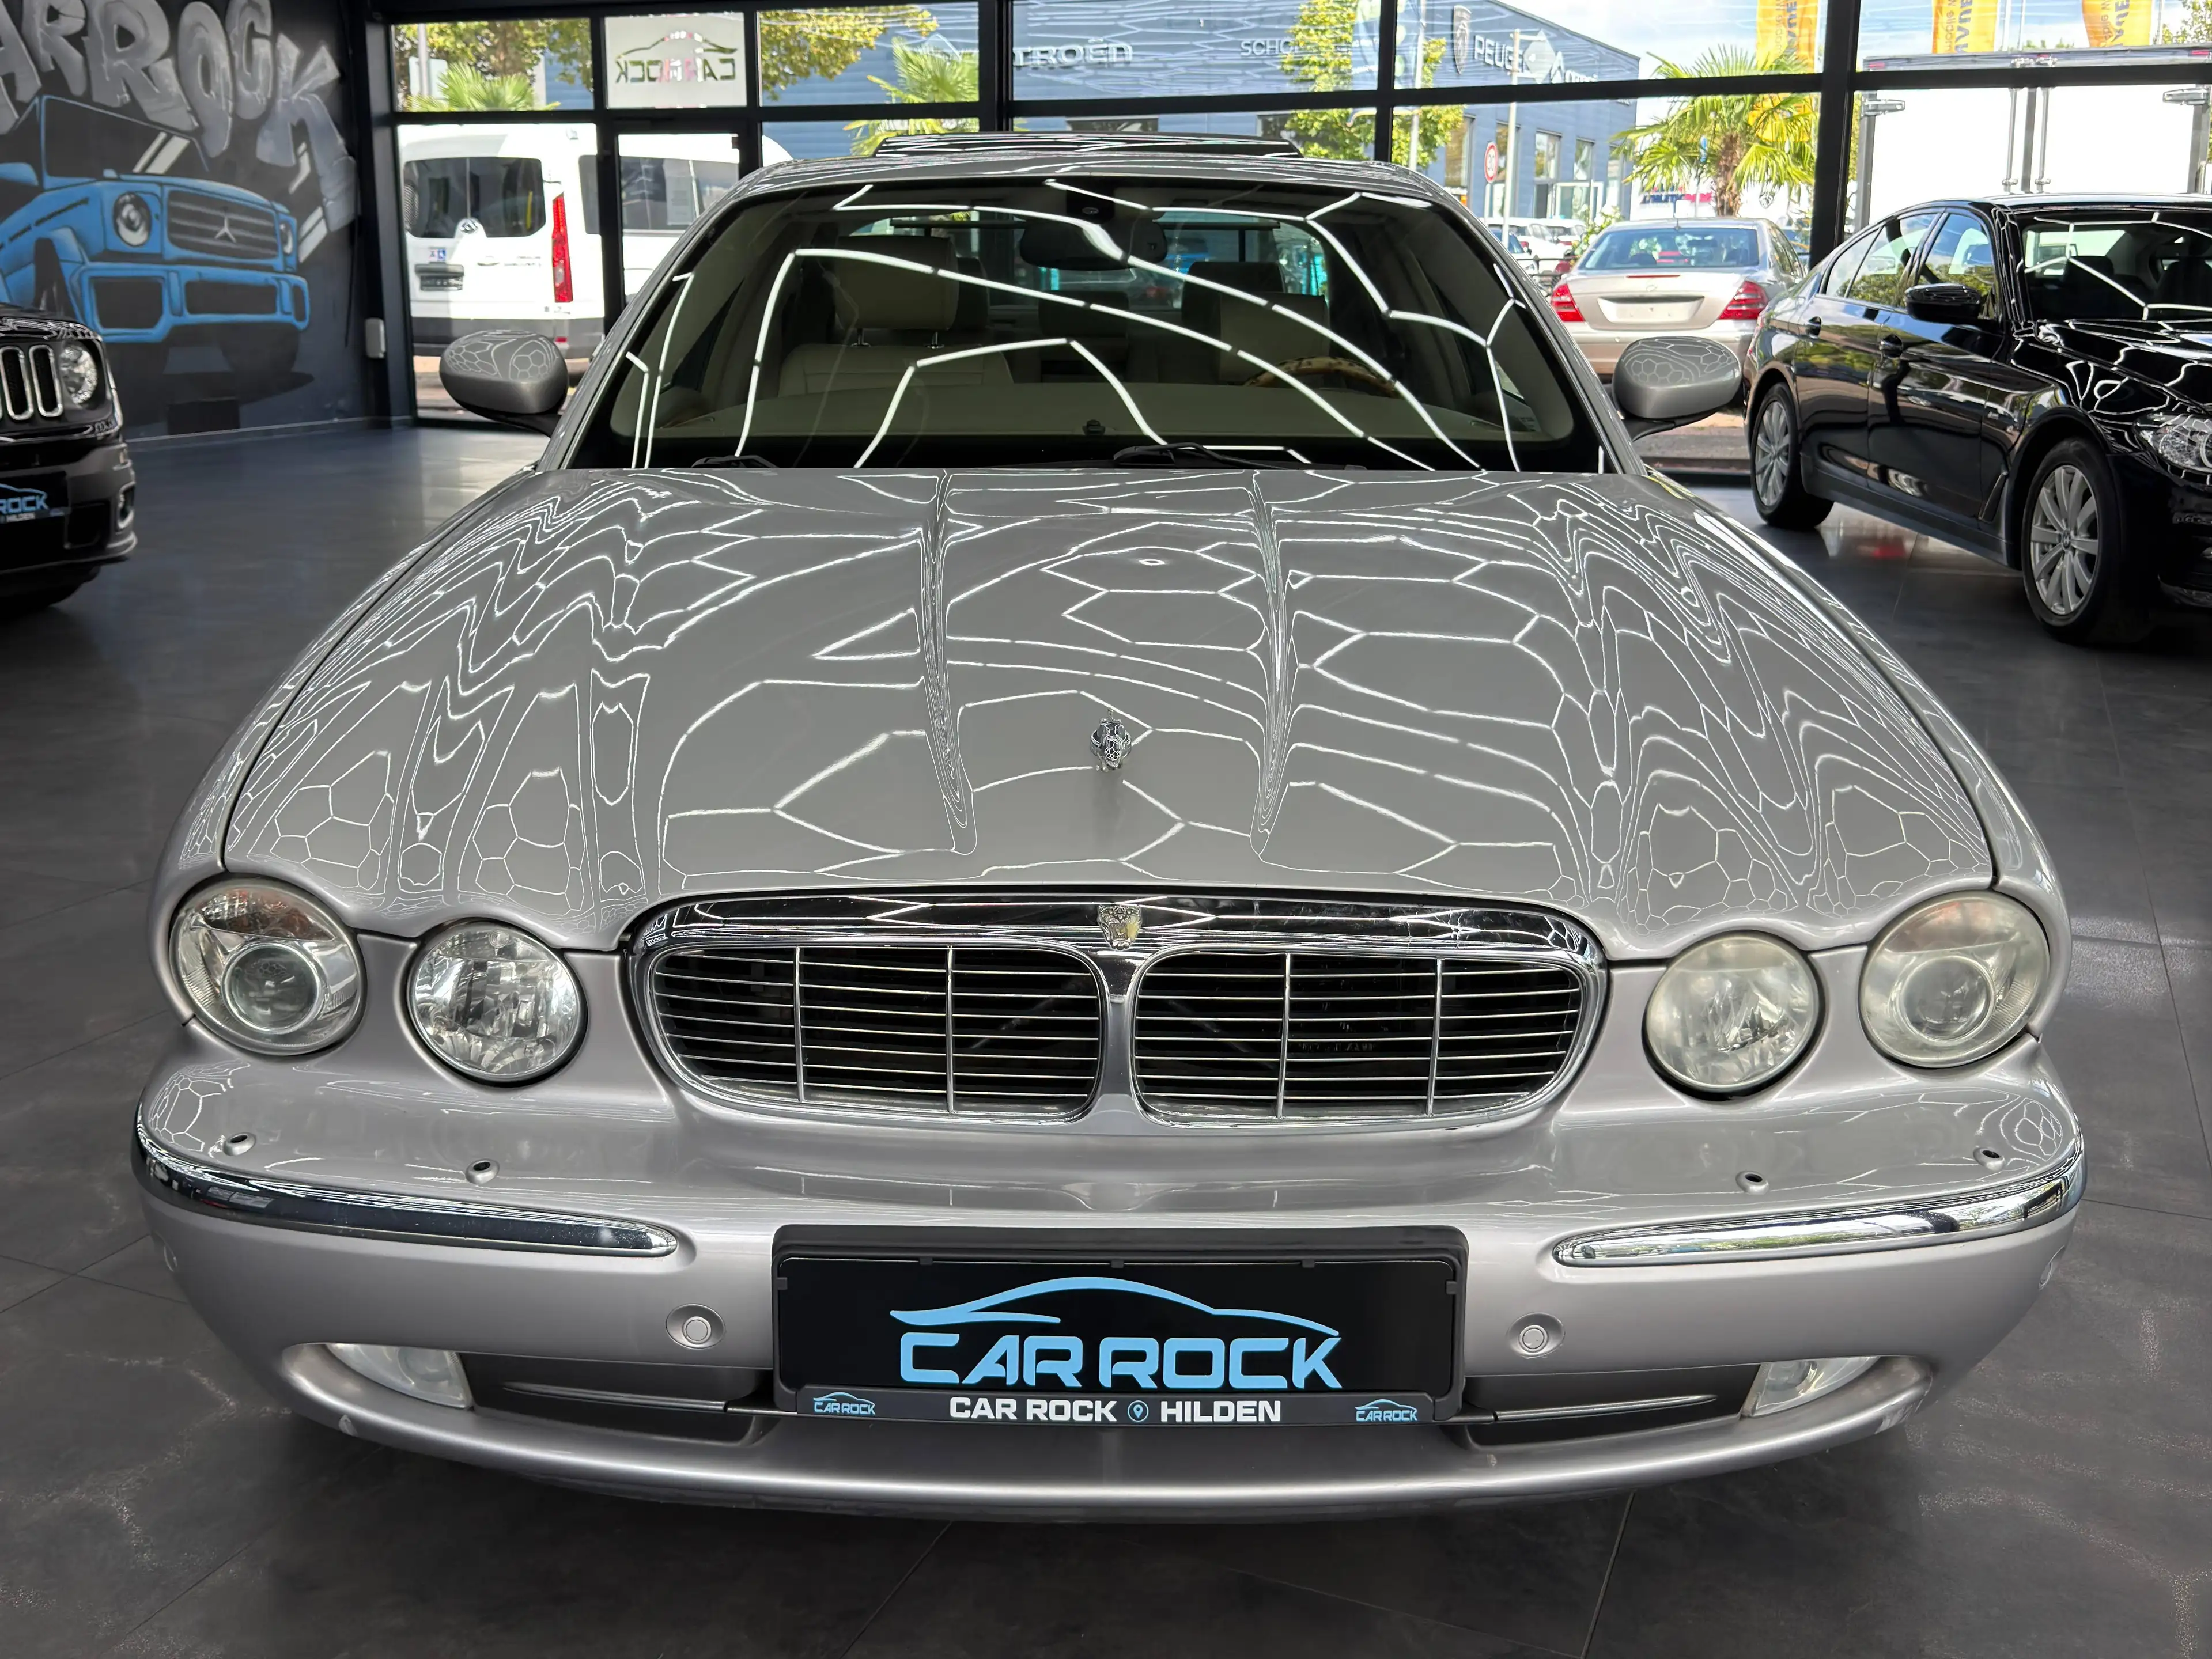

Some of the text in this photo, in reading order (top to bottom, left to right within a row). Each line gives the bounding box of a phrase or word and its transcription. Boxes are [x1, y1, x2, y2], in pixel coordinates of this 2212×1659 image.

[900, 1332, 1343, 1389] CAR ROCK
[950, 1397, 1280, 1422] CAR ROCK HILDEN
